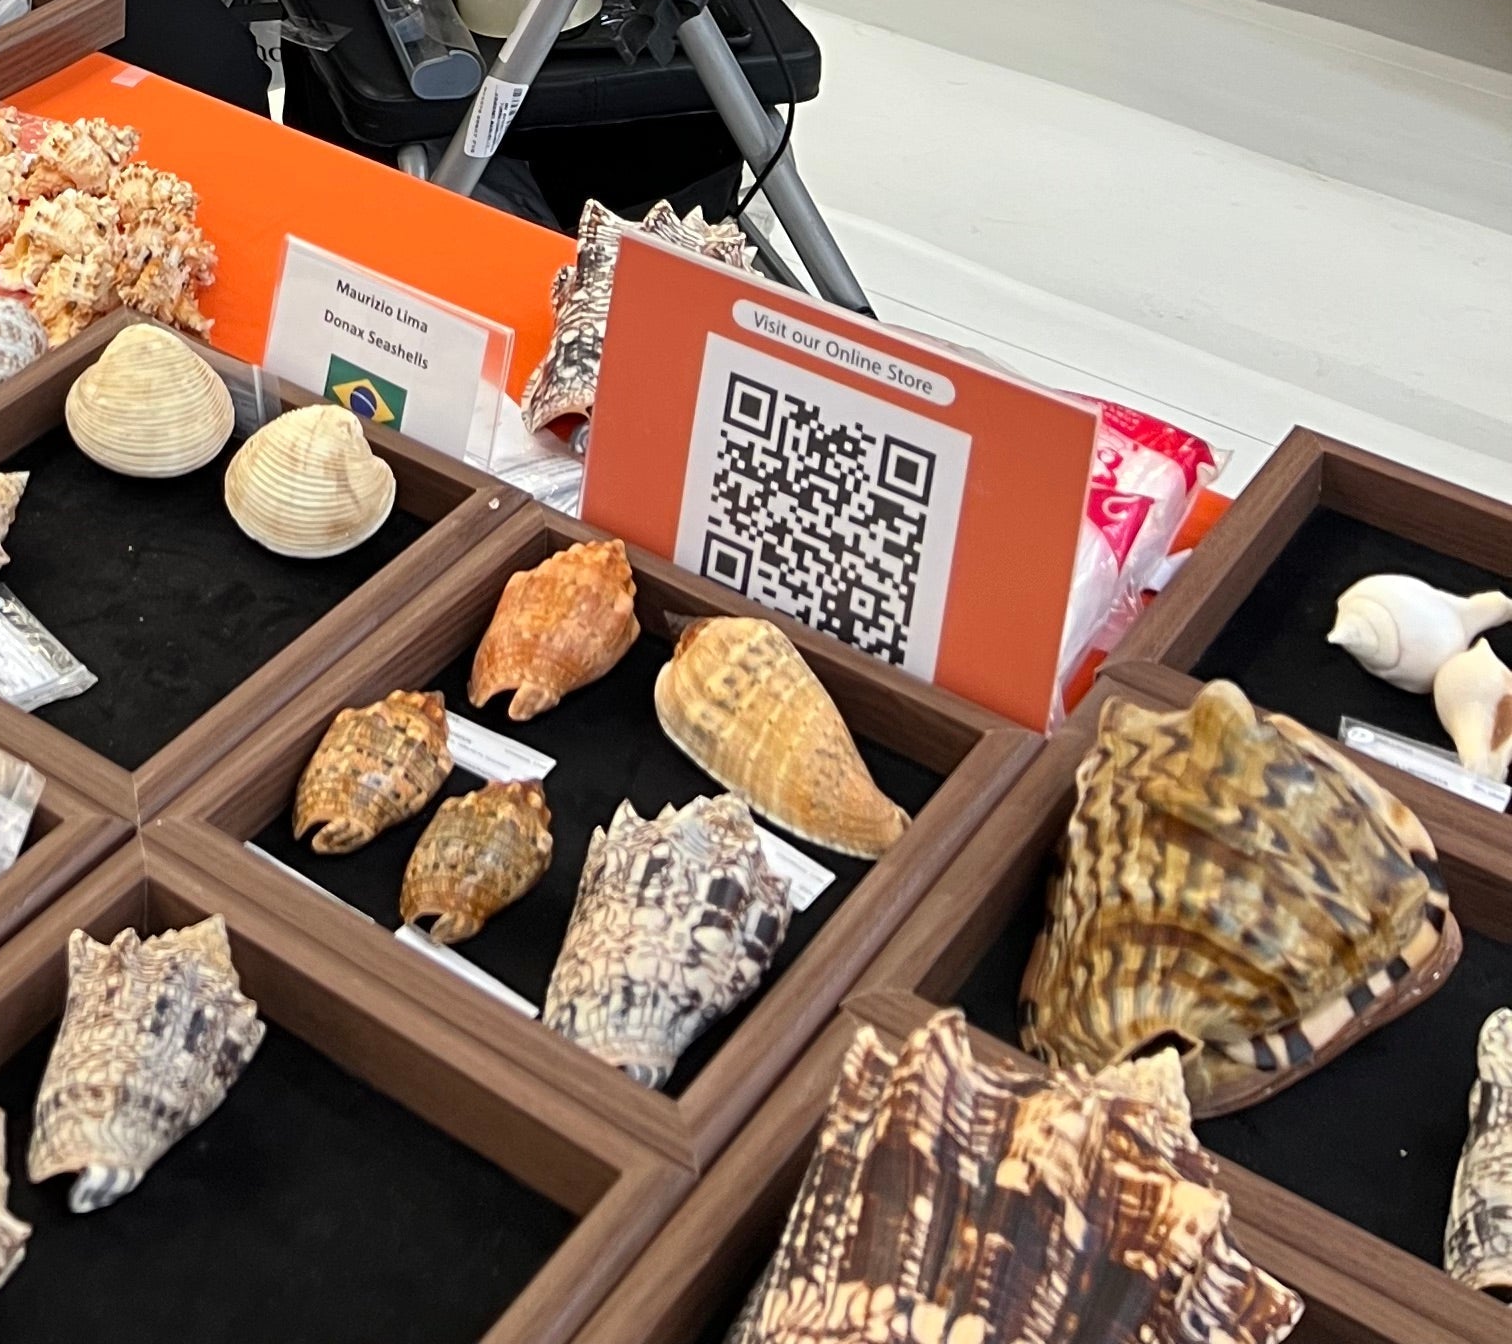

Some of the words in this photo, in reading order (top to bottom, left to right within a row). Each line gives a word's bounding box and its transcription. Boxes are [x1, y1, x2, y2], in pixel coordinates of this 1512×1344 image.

[336, 279, 393, 317] Maurizio
[396, 308, 428, 333] Lima
[324, 309, 365, 340] Donax
[368, 330, 429, 370] Seashells
[754, 310, 786, 339] Visit
[792, 330, 821, 351] our
[825, 340, 882, 375] Online
[887, 364, 933, 395] Store
